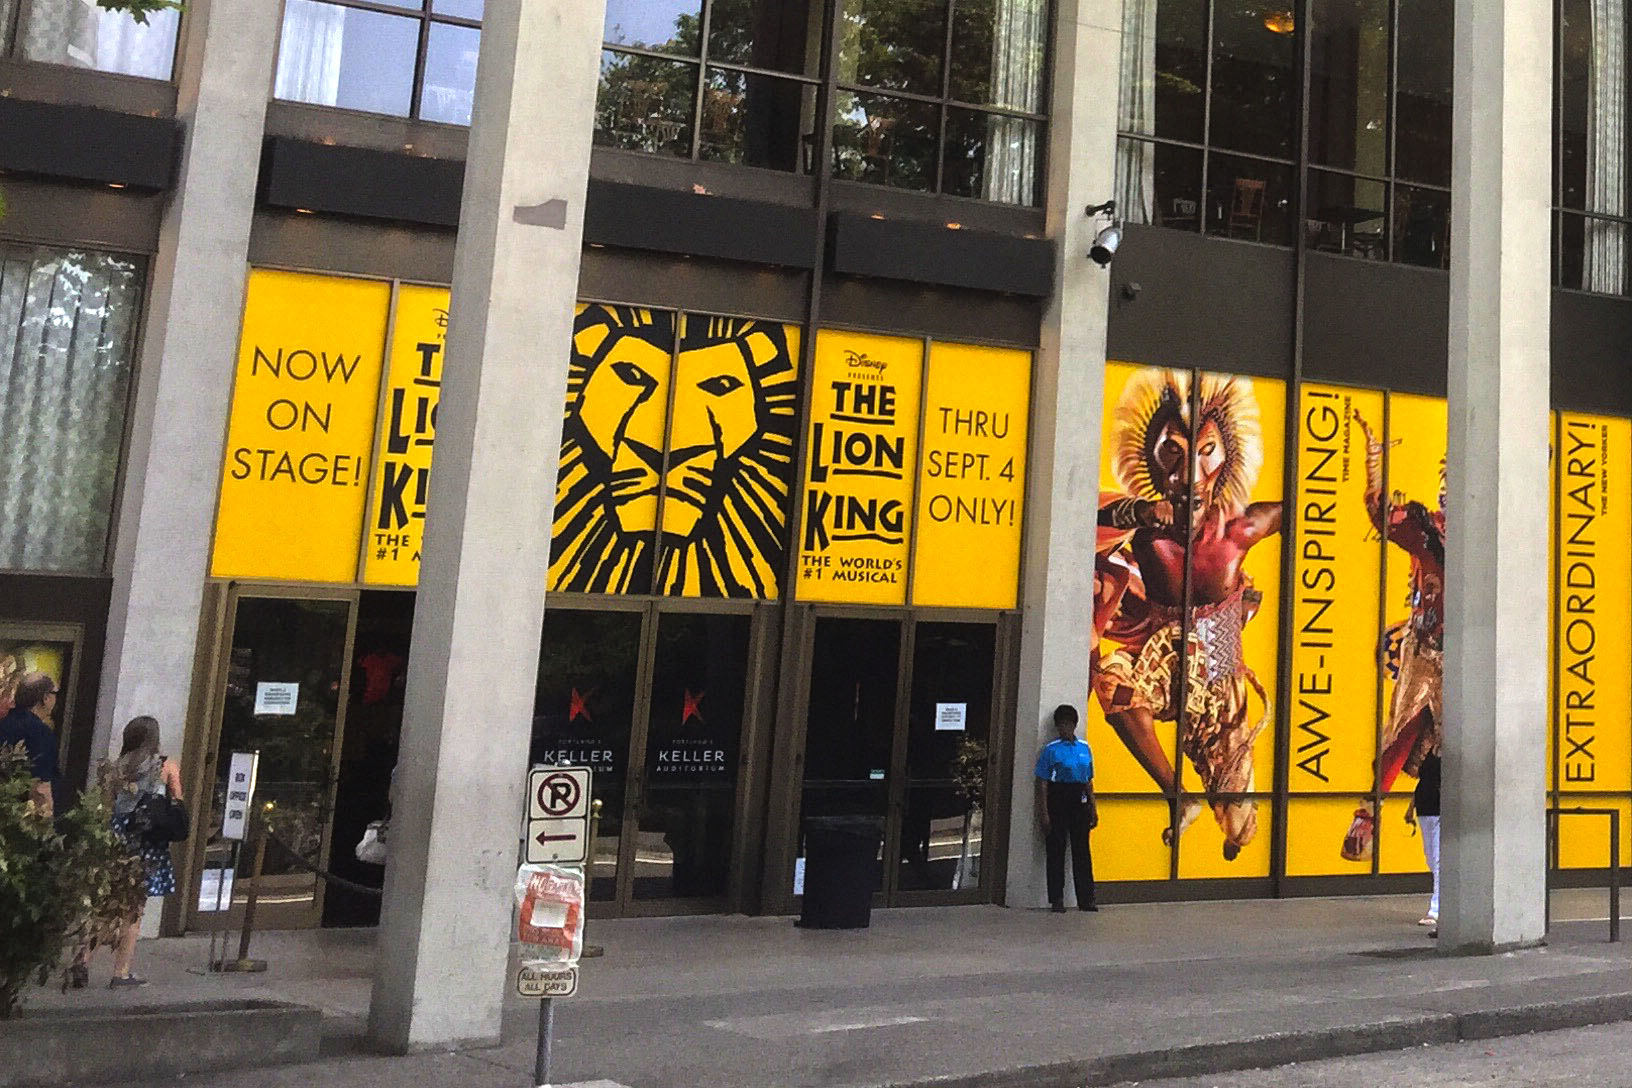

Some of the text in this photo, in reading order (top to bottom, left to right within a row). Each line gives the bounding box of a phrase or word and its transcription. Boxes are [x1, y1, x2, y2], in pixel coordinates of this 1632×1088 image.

[251, 345, 361, 384] NOW
[831, 381, 896, 416] THE
[266, 399, 331, 434] ON
[939, 407, 1009, 439] THRU
[810, 422, 905, 483] LION
[1342, 396, 1352, 482] TIME MAGAZINE
[231, 447, 362, 487] STAGE!
[927, 450, 1015, 483] SEPT. 4
[804, 489, 904, 552] KING
[928, 494, 1016, 526] ONLY!
[374, 533, 409, 547] THE
[375, 548, 398, 561] #1
[802, 555, 903, 571] THE WORLD'S
[803, 568, 897, 584] #1 MUSICAL
[1296, 391, 1340, 783] AWE-INSPIRING!
[1565, 421, 1597, 783] EXTRAORDINARY!
[544, 750, 613, 762] KELLER
[659, 750, 725, 762] KELLER
